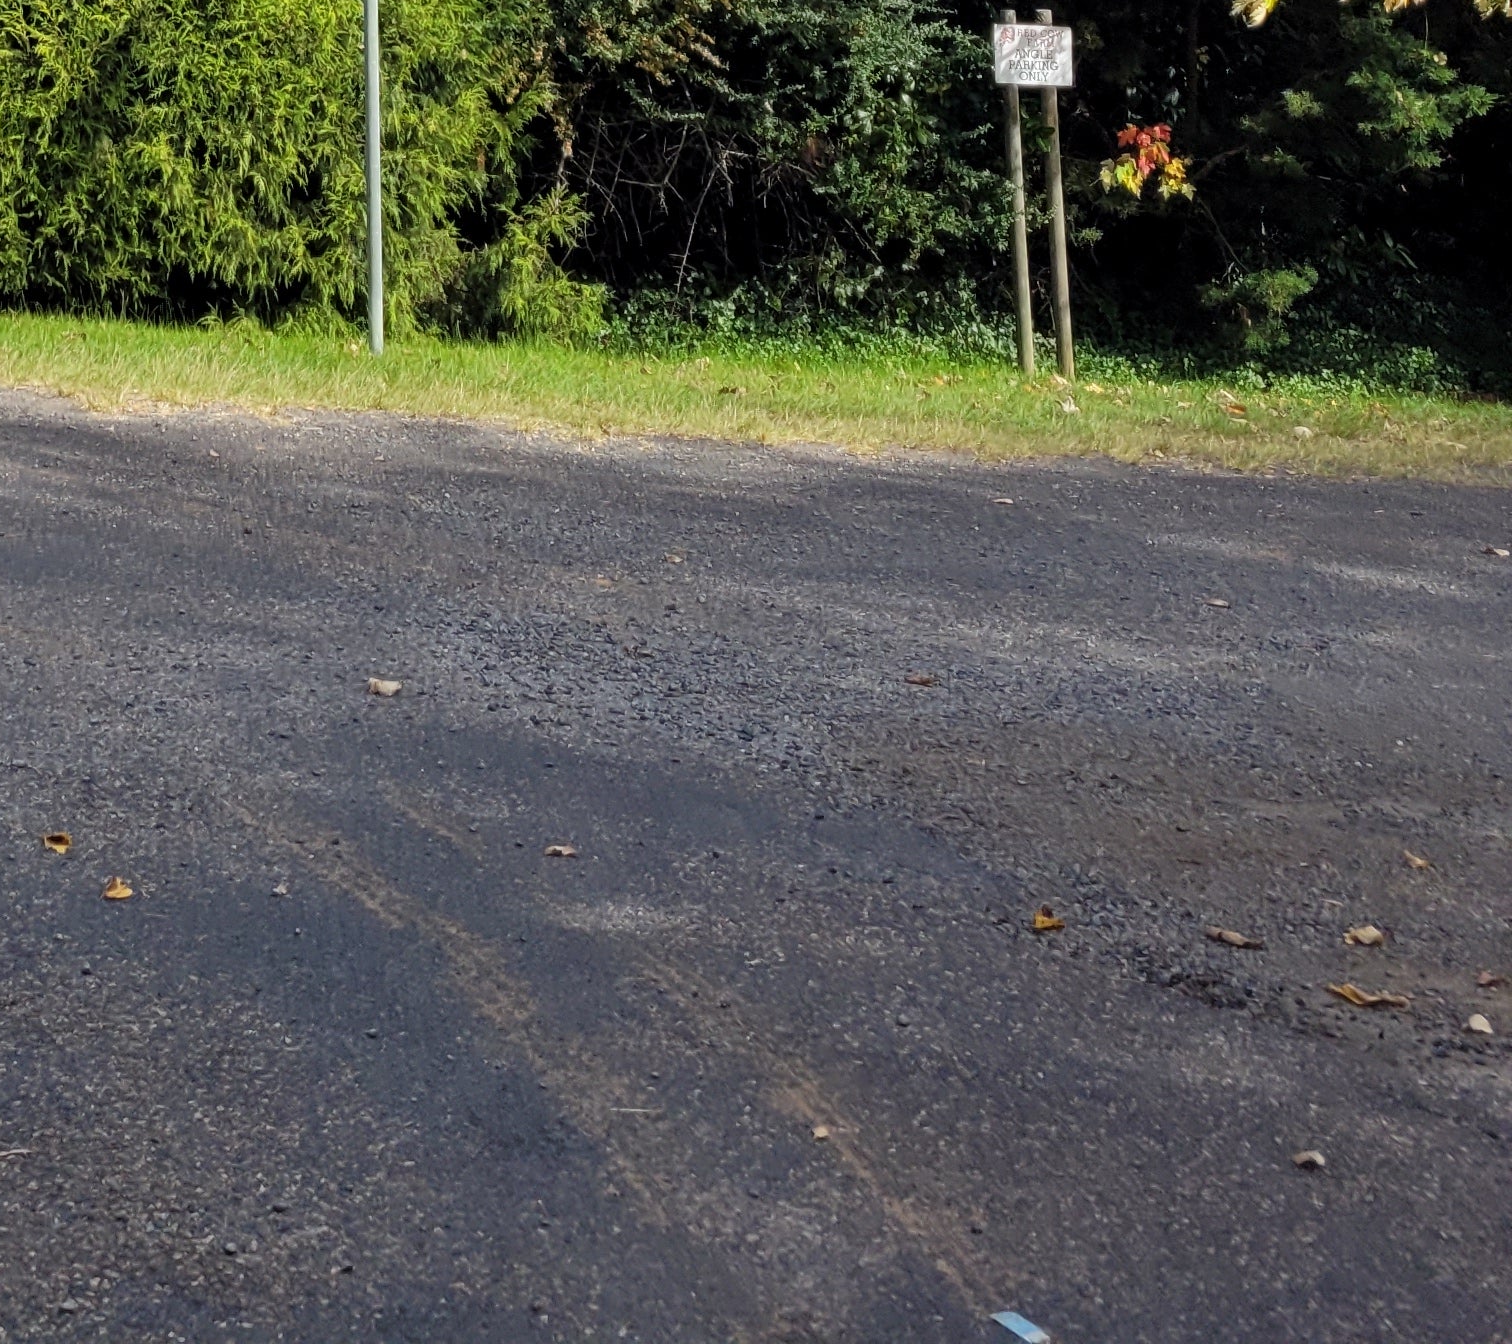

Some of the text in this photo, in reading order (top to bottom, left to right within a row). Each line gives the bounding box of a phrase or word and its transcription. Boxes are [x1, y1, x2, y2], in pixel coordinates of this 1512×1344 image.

[1040, 29, 1064, 39] COW
[1014, 49, 1053, 60] ANGLE
[1008, 59, 1059, 71] PARKING
[1018, 71, 1049, 82] ONLY
